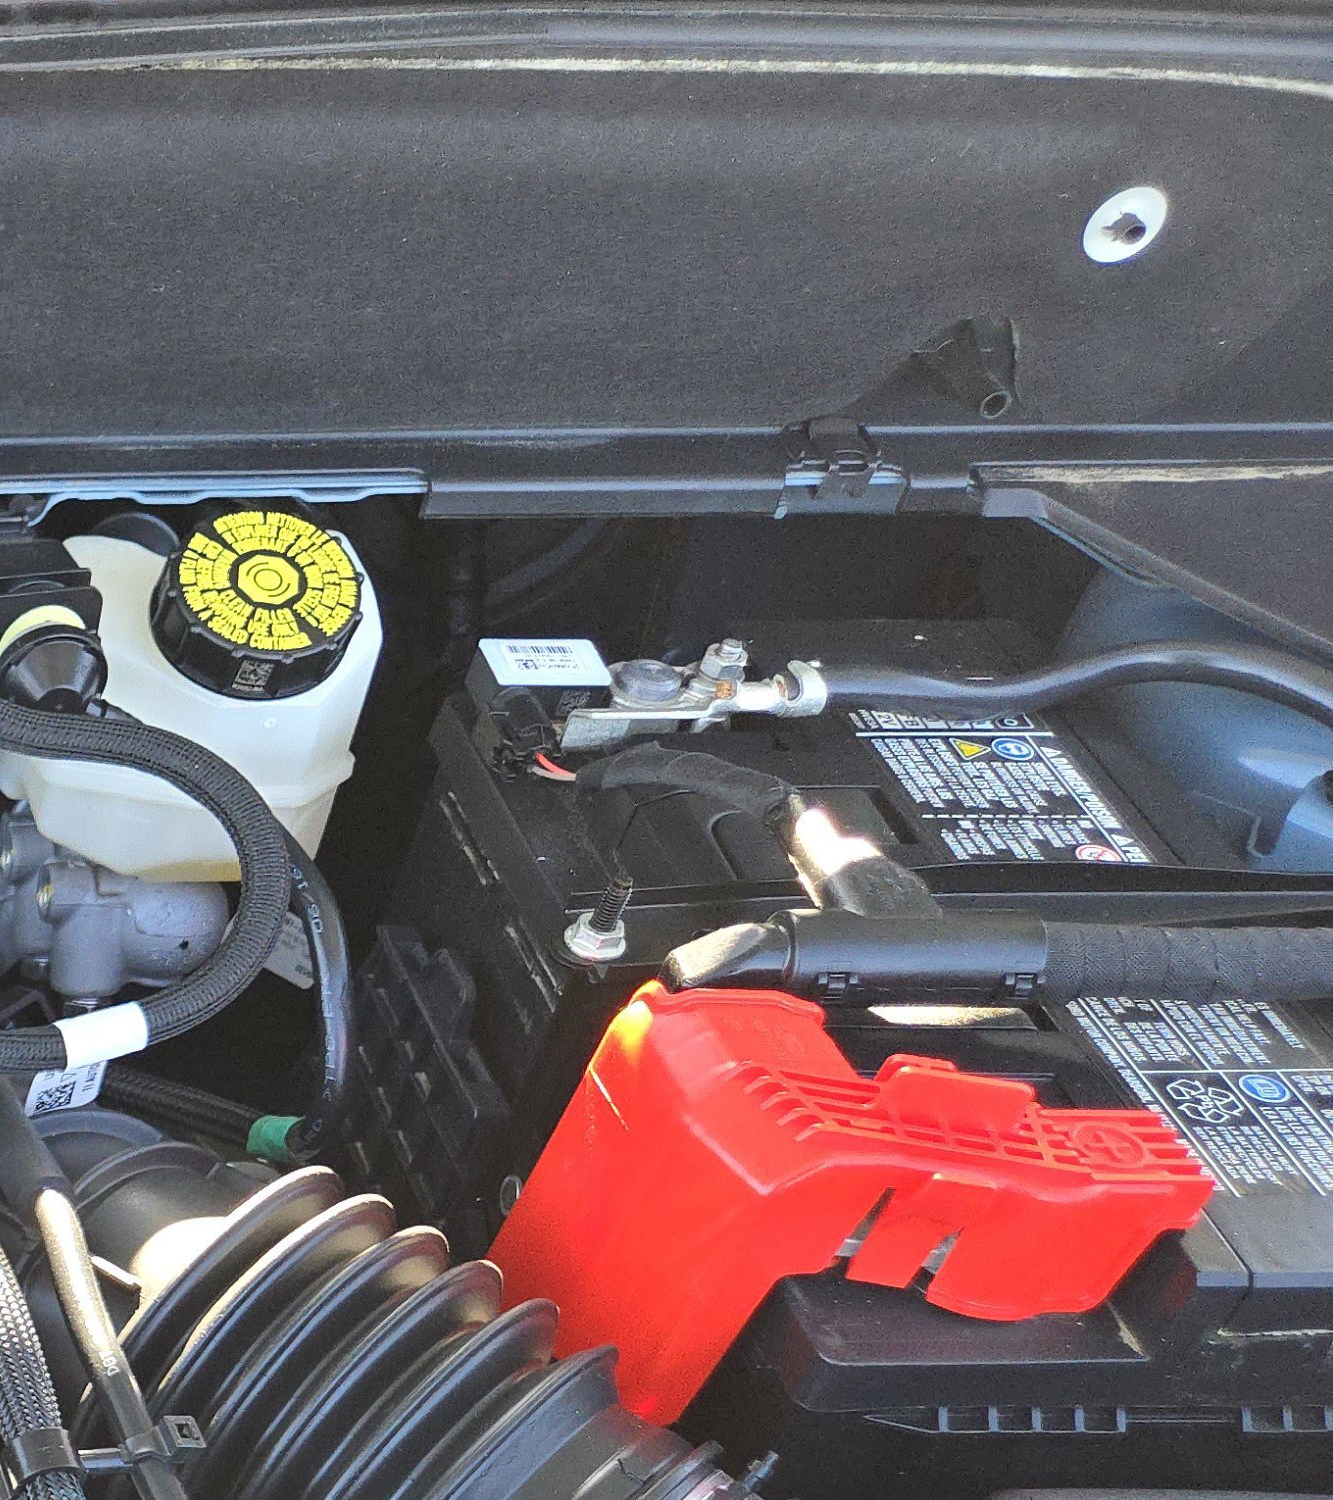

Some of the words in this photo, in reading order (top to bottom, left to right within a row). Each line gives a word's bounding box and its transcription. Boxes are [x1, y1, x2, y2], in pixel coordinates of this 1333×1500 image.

[1048, 757, 1122, 828] DANGER/POISON
[1118, 846, 1150, 862] PE
[1257, 1106, 1280, 1119] LEA
[1268, 1120, 1292, 1133] LAS
[1246, 1135, 1284, 1170] RECYCLED
[1248, 1125, 1283, 1156] BATTERY
